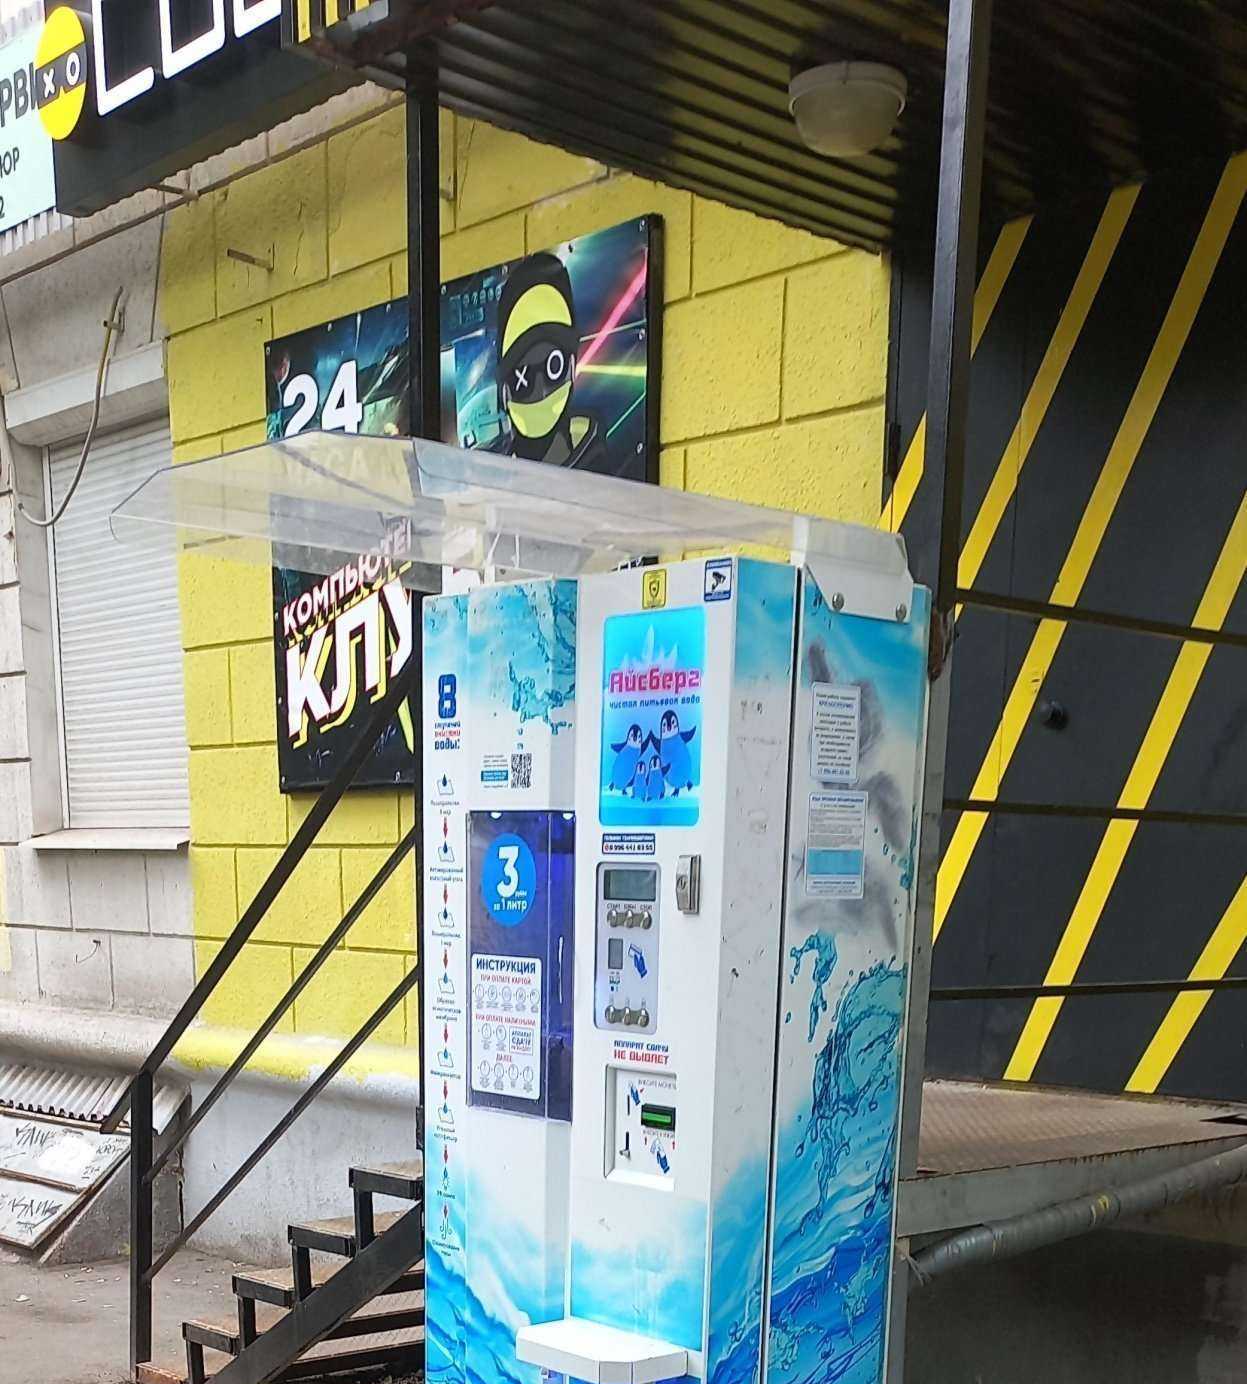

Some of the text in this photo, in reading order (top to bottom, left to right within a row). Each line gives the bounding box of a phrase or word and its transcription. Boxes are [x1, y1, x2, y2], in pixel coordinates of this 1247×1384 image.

[283, 360, 363, 437] 24
[609, 666, 701, 694] Айсберг
[438, 674, 457, 719] 8
[496, 845, 520, 898] 3
[506, 900, 528, 912] литр
[476, 957, 536, 974] ИНСТРУКЦИЯ
[613, 1049, 626, 1060] НЕ
